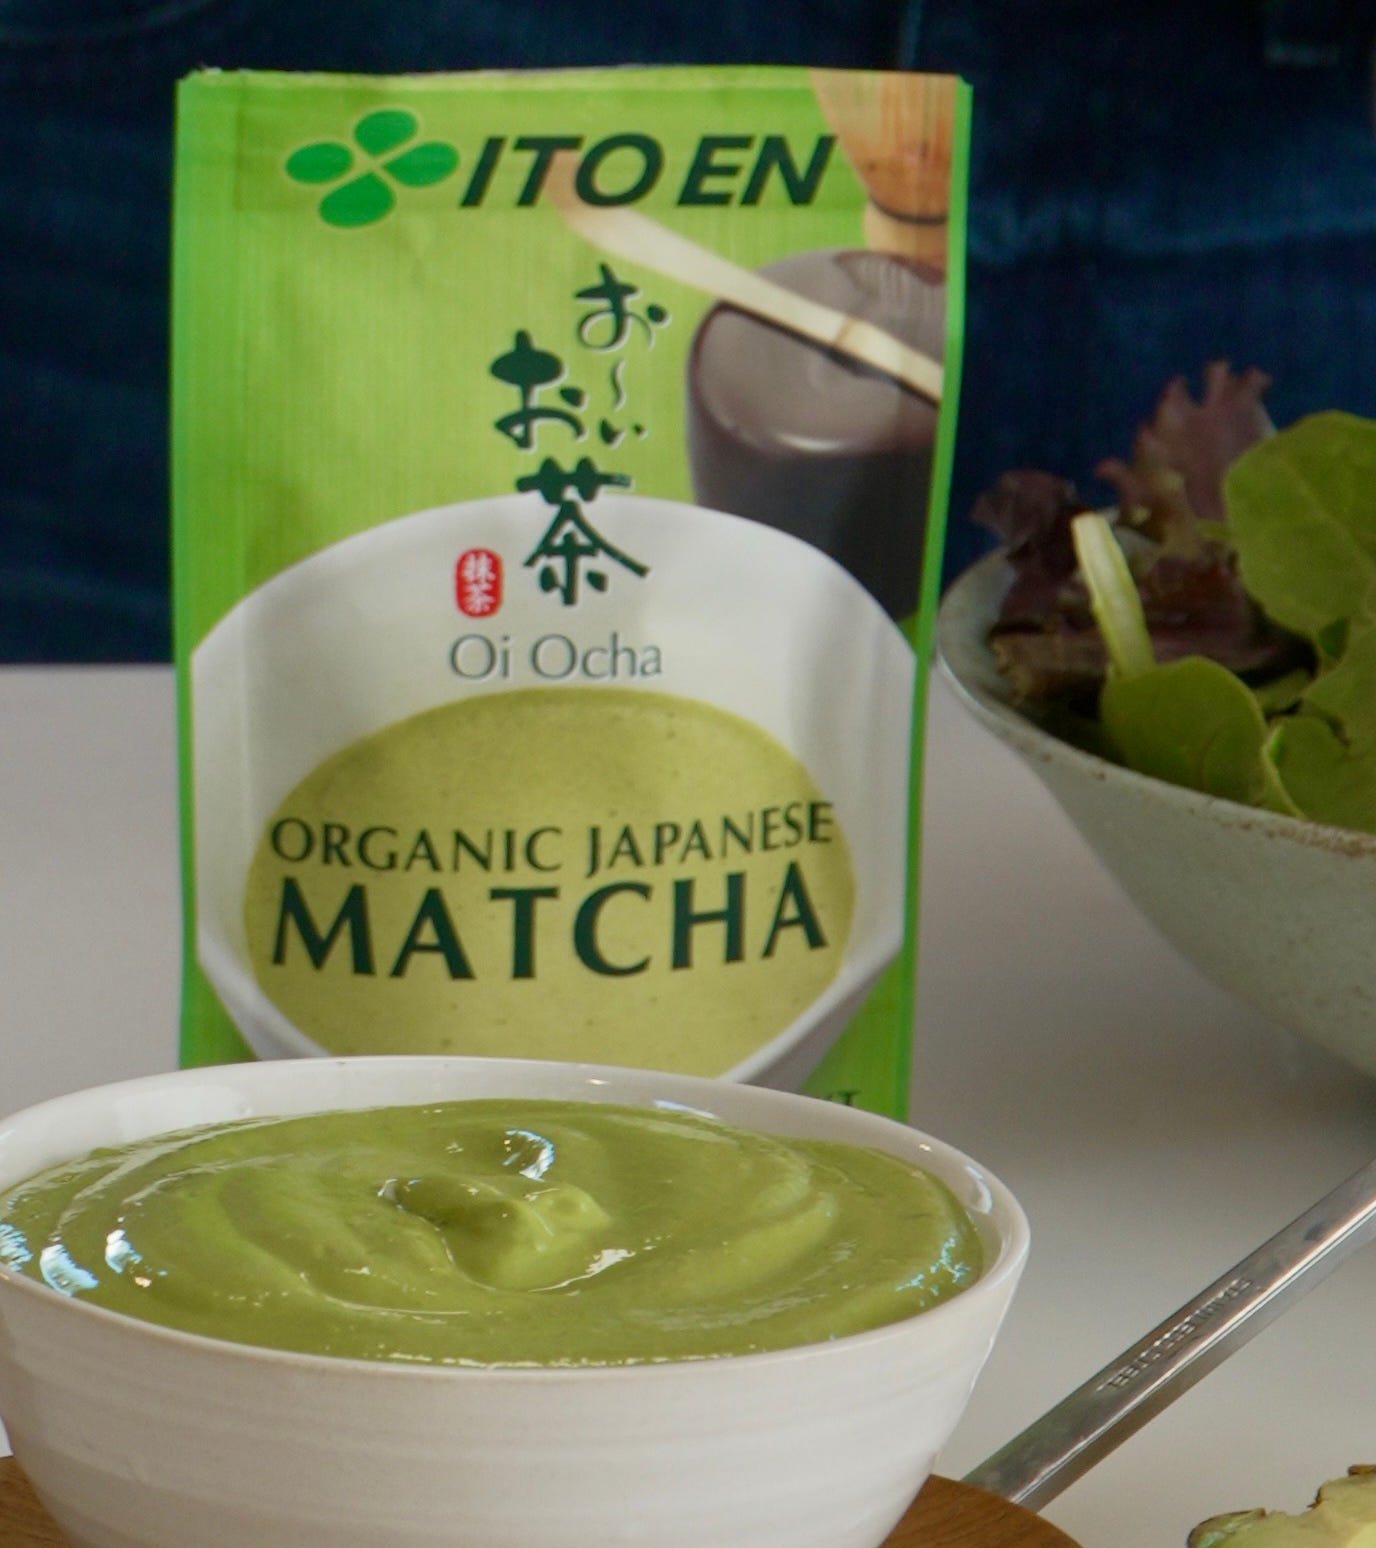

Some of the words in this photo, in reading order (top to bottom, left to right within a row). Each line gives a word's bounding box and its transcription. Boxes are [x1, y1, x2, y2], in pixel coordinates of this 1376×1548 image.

[459, 133, 664, 208] ITO
[675, 133, 837, 208] EN
[450, 633, 510, 680] Oi
[529, 631, 662, 680] Ocha
[270, 816, 563, 874] ORGANIC
[586, 800, 834, 879] JAPANESE
[271, 860, 829, 981] MATCHA
